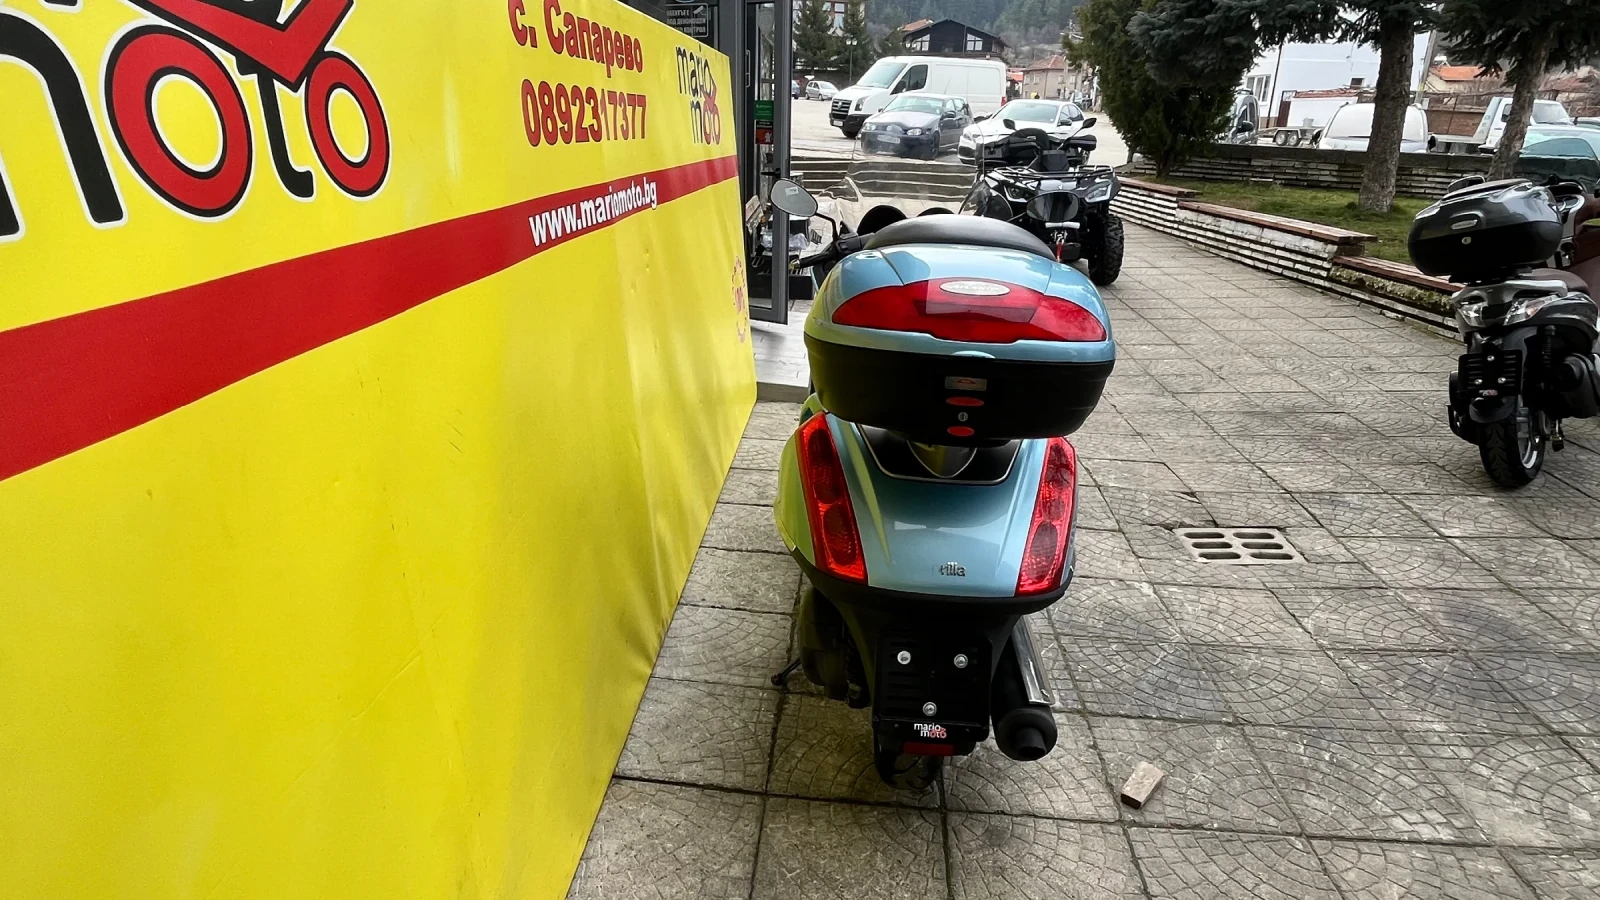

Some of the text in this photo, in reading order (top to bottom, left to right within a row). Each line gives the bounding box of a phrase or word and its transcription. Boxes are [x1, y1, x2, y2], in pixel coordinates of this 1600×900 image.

[543, 0, 643, 78] Сапарево
[676, 44, 717, 98] mario
[521, 78, 647, 147] 0892317377
[528, 176, 658, 247] www.mariomoto.bg
[913, 722, 941, 731] mario
[920, 730, 947, 739] moto
